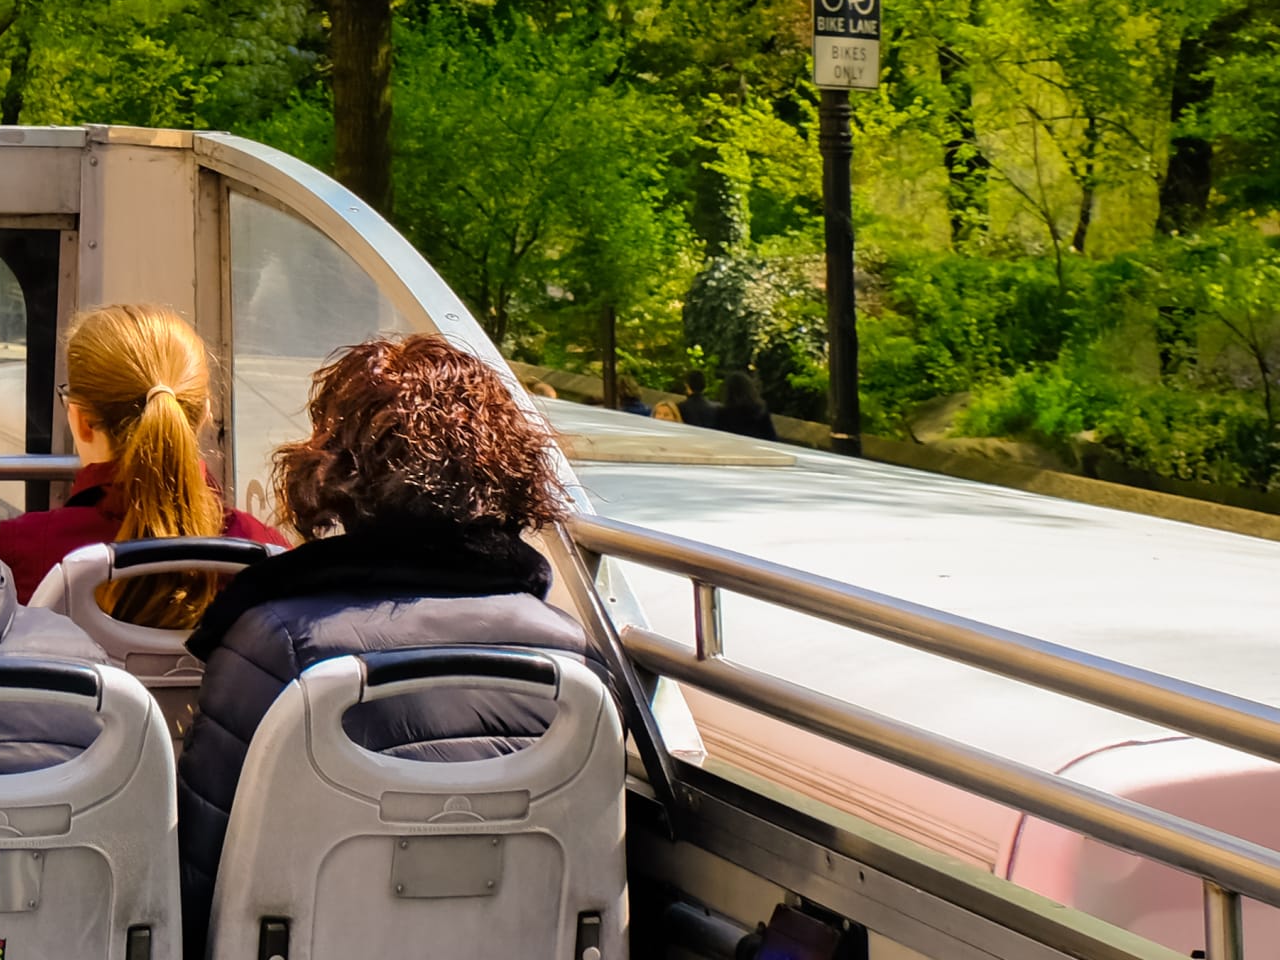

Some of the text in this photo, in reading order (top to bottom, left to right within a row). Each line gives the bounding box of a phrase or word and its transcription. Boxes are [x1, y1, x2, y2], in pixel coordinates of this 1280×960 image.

[817, 16, 878, 35] BIKE LANE
[832, 45, 866, 61] BIKES
[834, 65, 864, 80] ONLY
